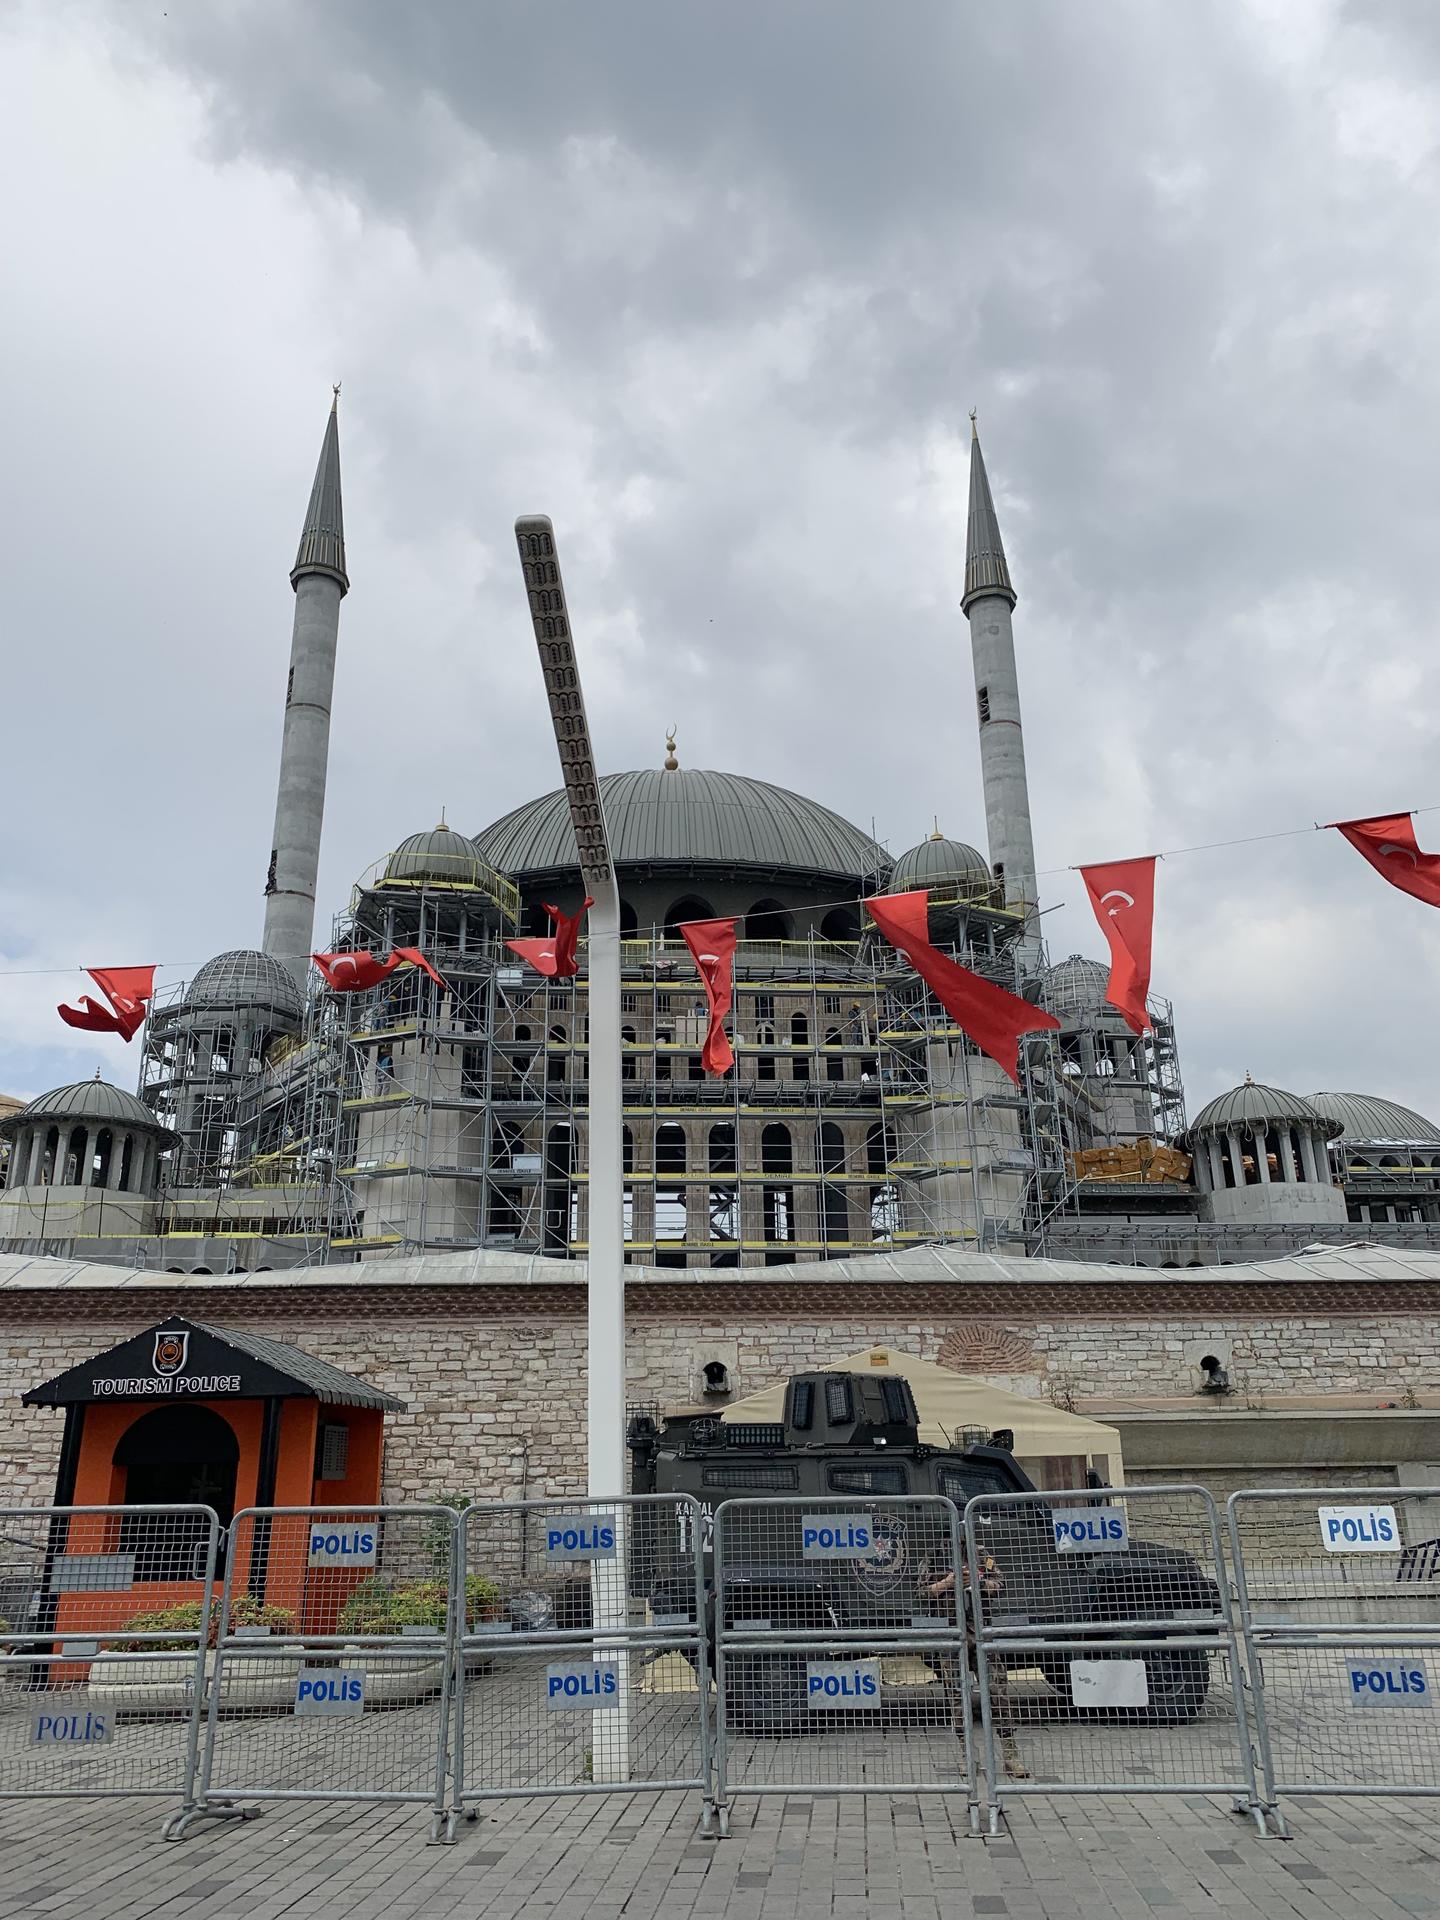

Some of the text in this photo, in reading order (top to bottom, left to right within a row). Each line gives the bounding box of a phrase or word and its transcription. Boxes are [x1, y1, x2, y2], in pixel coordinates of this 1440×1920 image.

[93, 1375, 241, 1395] TOURISM POLICE
[676, 1502, 713, 1515] KAAL
[548, 1521, 615, 1552] POLİS
[803, 1521, 870, 1549] POLİS
[1055, 1516, 1124, 1542] POLİS
[1328, 1512, 1394, 1543] POLİS
[311, 1529, 374, 1555] POLİS
[298, 1673, 363, 1702] POLİS
[548, 1668, 617, 1697] POLİS
[809, 1670, 877, 1697] POLİS
[1351, 1665, 1426, 1694] POLİS
[36, 1710, 106, 1742] POLİS
